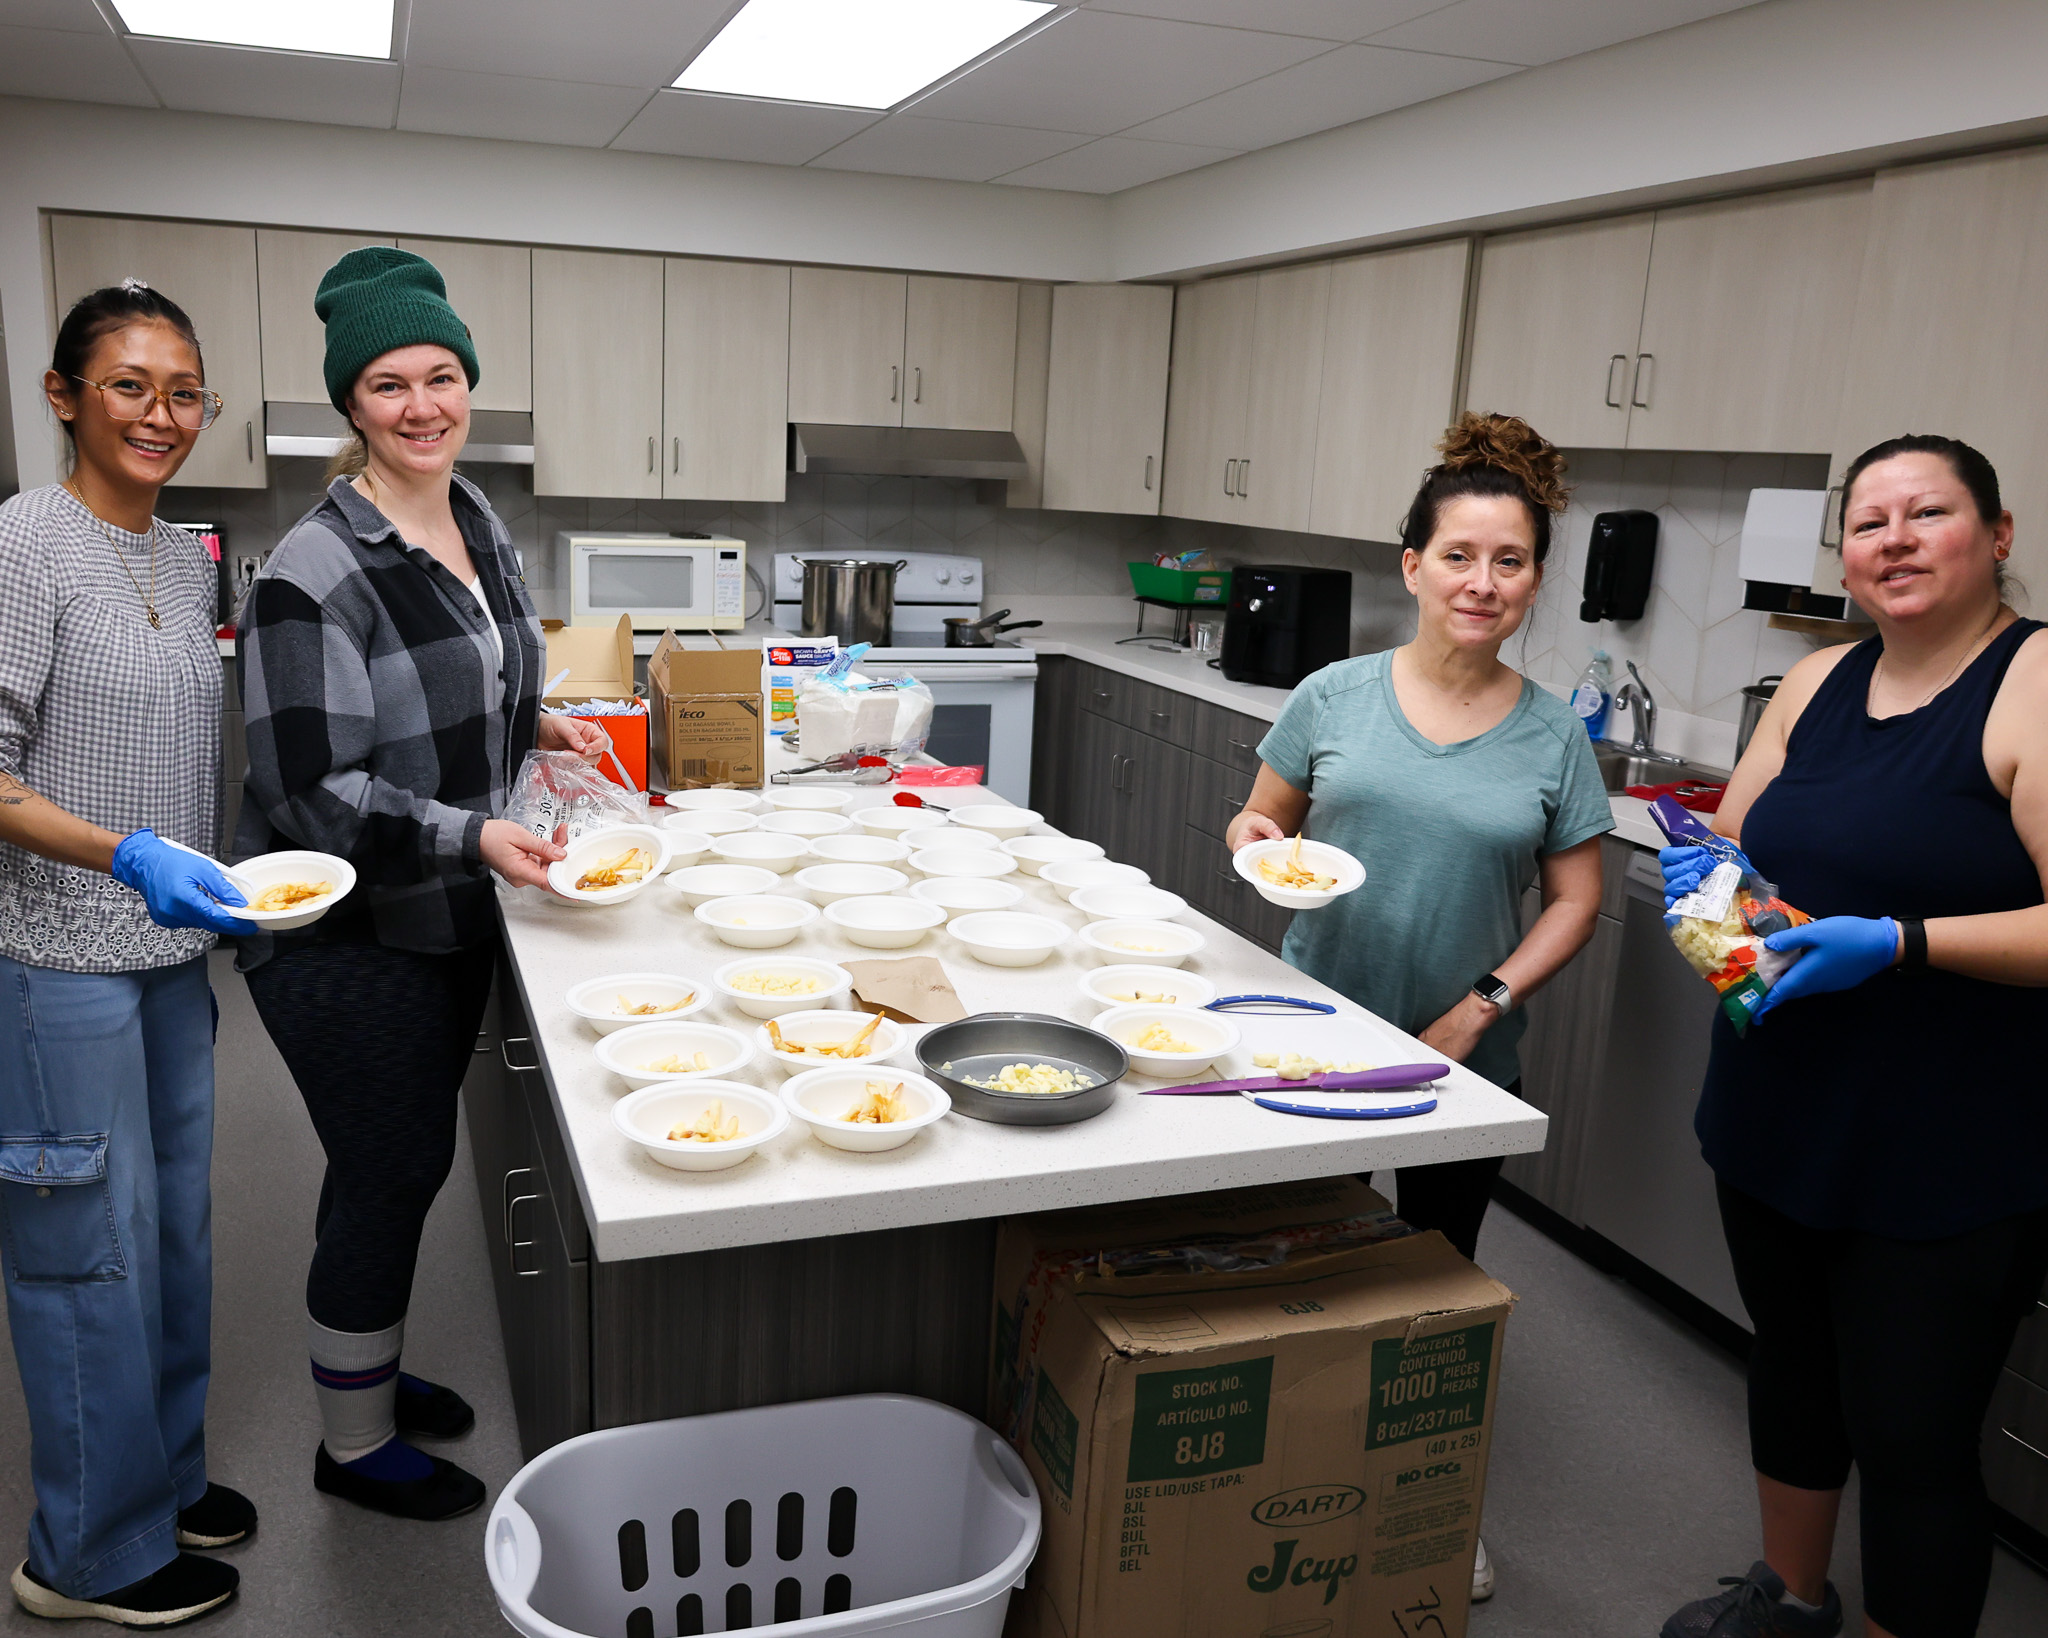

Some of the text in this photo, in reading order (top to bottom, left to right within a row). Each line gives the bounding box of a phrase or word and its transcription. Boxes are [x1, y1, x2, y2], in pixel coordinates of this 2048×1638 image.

[1280, 1301, 1325, 1315] 8J8
[1403, 1333, 1466, 1356] CONTENTS
[1399, 1348, 1467, 1374] CONTENIDO
[1442, 1360, 1480, 1379] PIECES
[1172, 1376, 1244, 1400] STOCK NO.
[1379, 1370, 1438, 1408] 1000
[1442, 1376, 1479, 1395] PIEZAS
[1156, 1400, 1252, 1426] ARTÍCULO NO.
[1448, 1402, 1474, 1426] mL
[1174, 1430, 1226, 1465] 8J8
[1426, 1430, 1481, 1457] (40 x 25)
[1396, 1461, 1462, 1486] NO CFCs
[1125, 1474, 1245, 1500] USE LID/USE TAPA:
[1124, 1501, 1146, 1514] 8JL
[1264, 1492, 1354, 1520] DART
[1122, 1516, 1147, 1529] 8SL
[1121, 1530, 1146, 1543] 8UL
[1120, 1544, 1150, 1558] 8FTL
[1119, 1560, 1142, 1572] 8EL
[1247, 1539, 1358, 1606] Jcup
